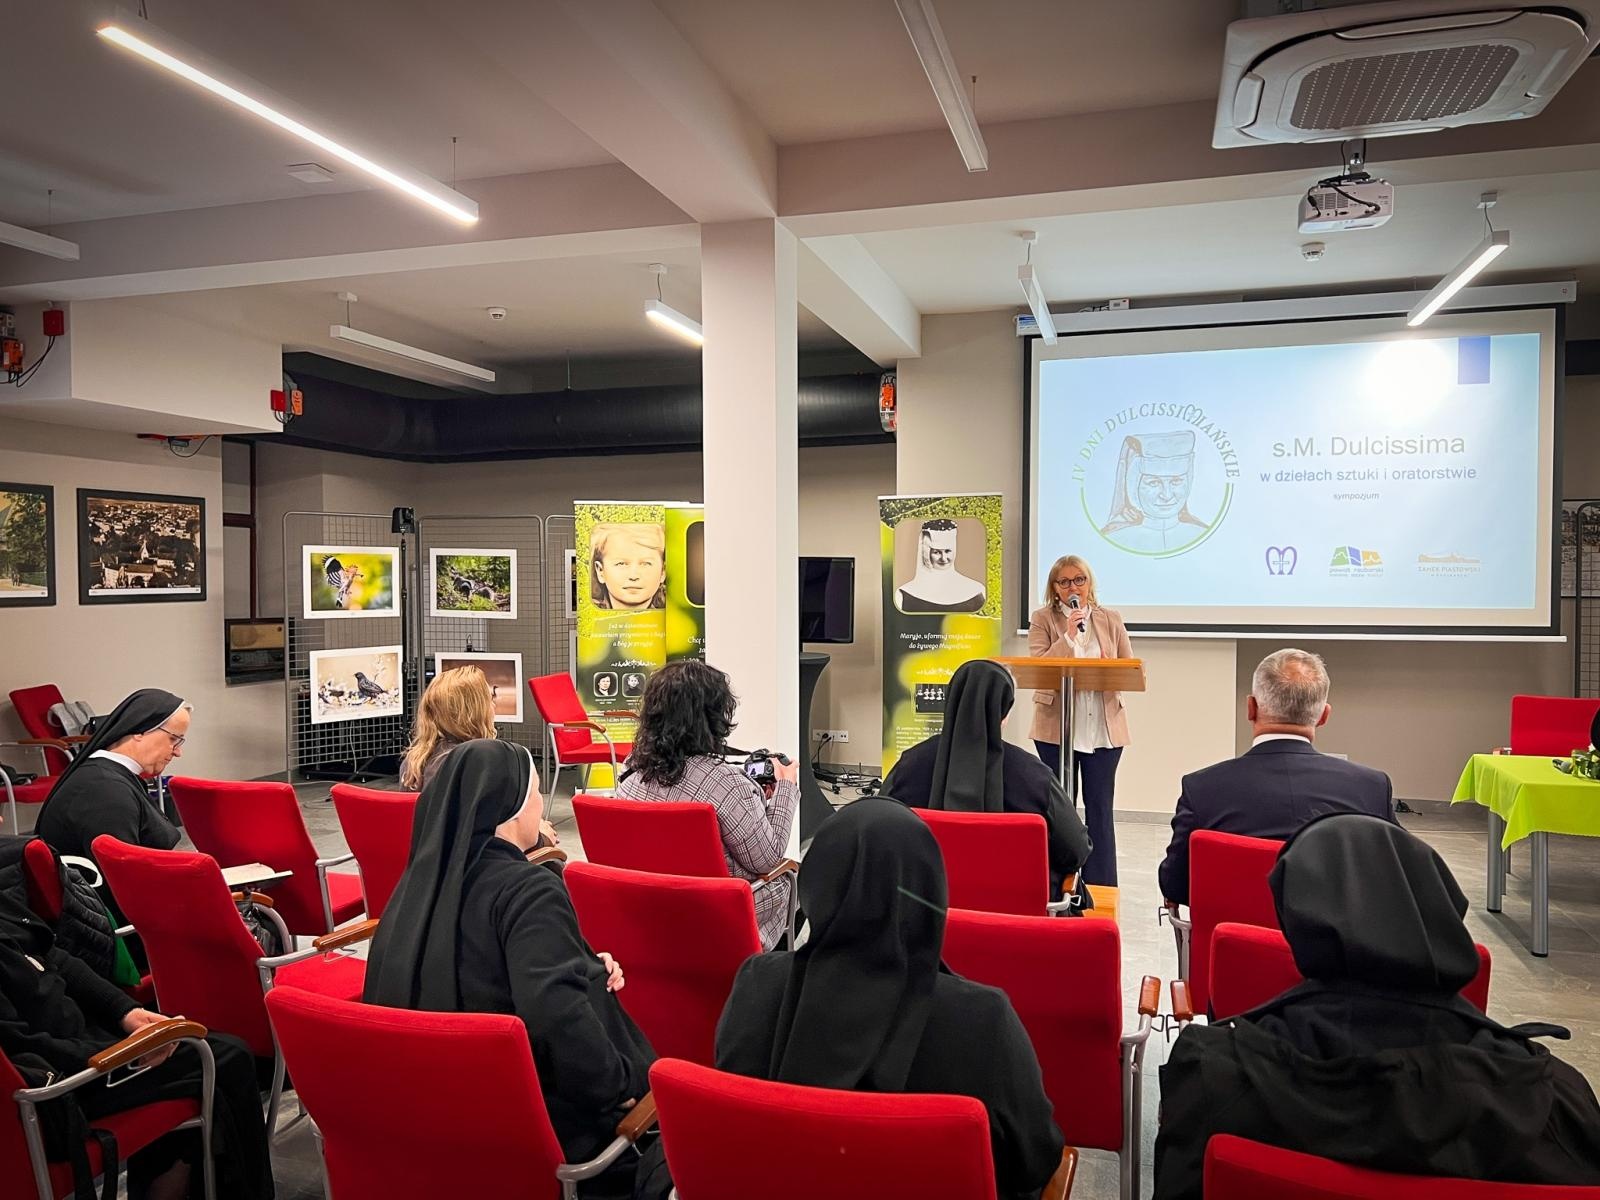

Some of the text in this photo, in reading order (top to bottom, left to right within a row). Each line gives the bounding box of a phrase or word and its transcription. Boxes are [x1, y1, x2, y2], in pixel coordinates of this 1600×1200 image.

[1072, 464, 1085, 482] IV
[1080, 429, 1105, 460] DNI
[1272, 434, 1465, 457] s.M. Dulcissima
[1260, 472, 1270, 482] w
[1275, 468, 1332, 482] dziełach
[1337, 467, 1379, 481] sztuki
[1392, 465, 1477, 480] oratorstwie
[1333, 491, 1380, 501] sympozjum
